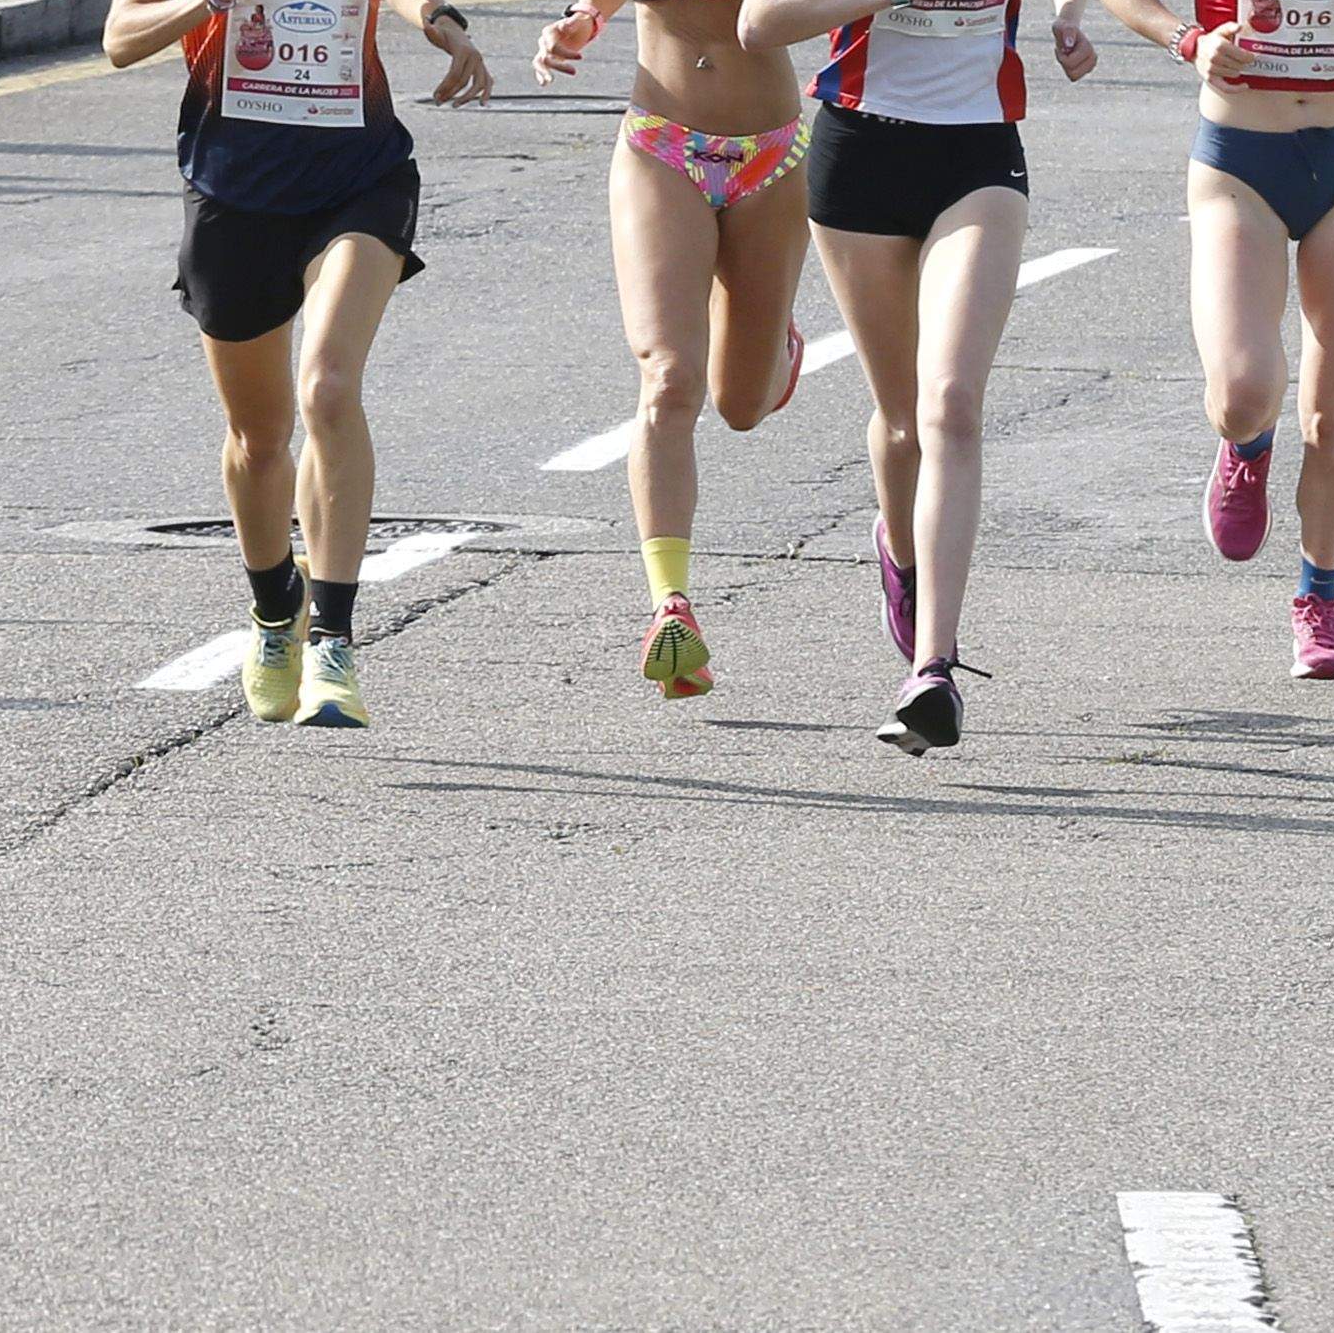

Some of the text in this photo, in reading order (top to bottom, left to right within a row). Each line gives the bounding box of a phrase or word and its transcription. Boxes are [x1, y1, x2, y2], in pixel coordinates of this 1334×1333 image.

[278, 9, 333, 26] ASTURIANA
[888, 12, 933, 27] OYSHO
[1286, 9, 1332, 26] 016
[1299, 31, 1314, 42] 29
[279, 43, 329, 63] 016
[1290, 47, 1301, 55] DE
[1303, 47, 1314, 55] LA
[294, 69, 311, 81] 24
[299, 87, 310, 95] LA
[237, 99, 283, 113] OYSHO
